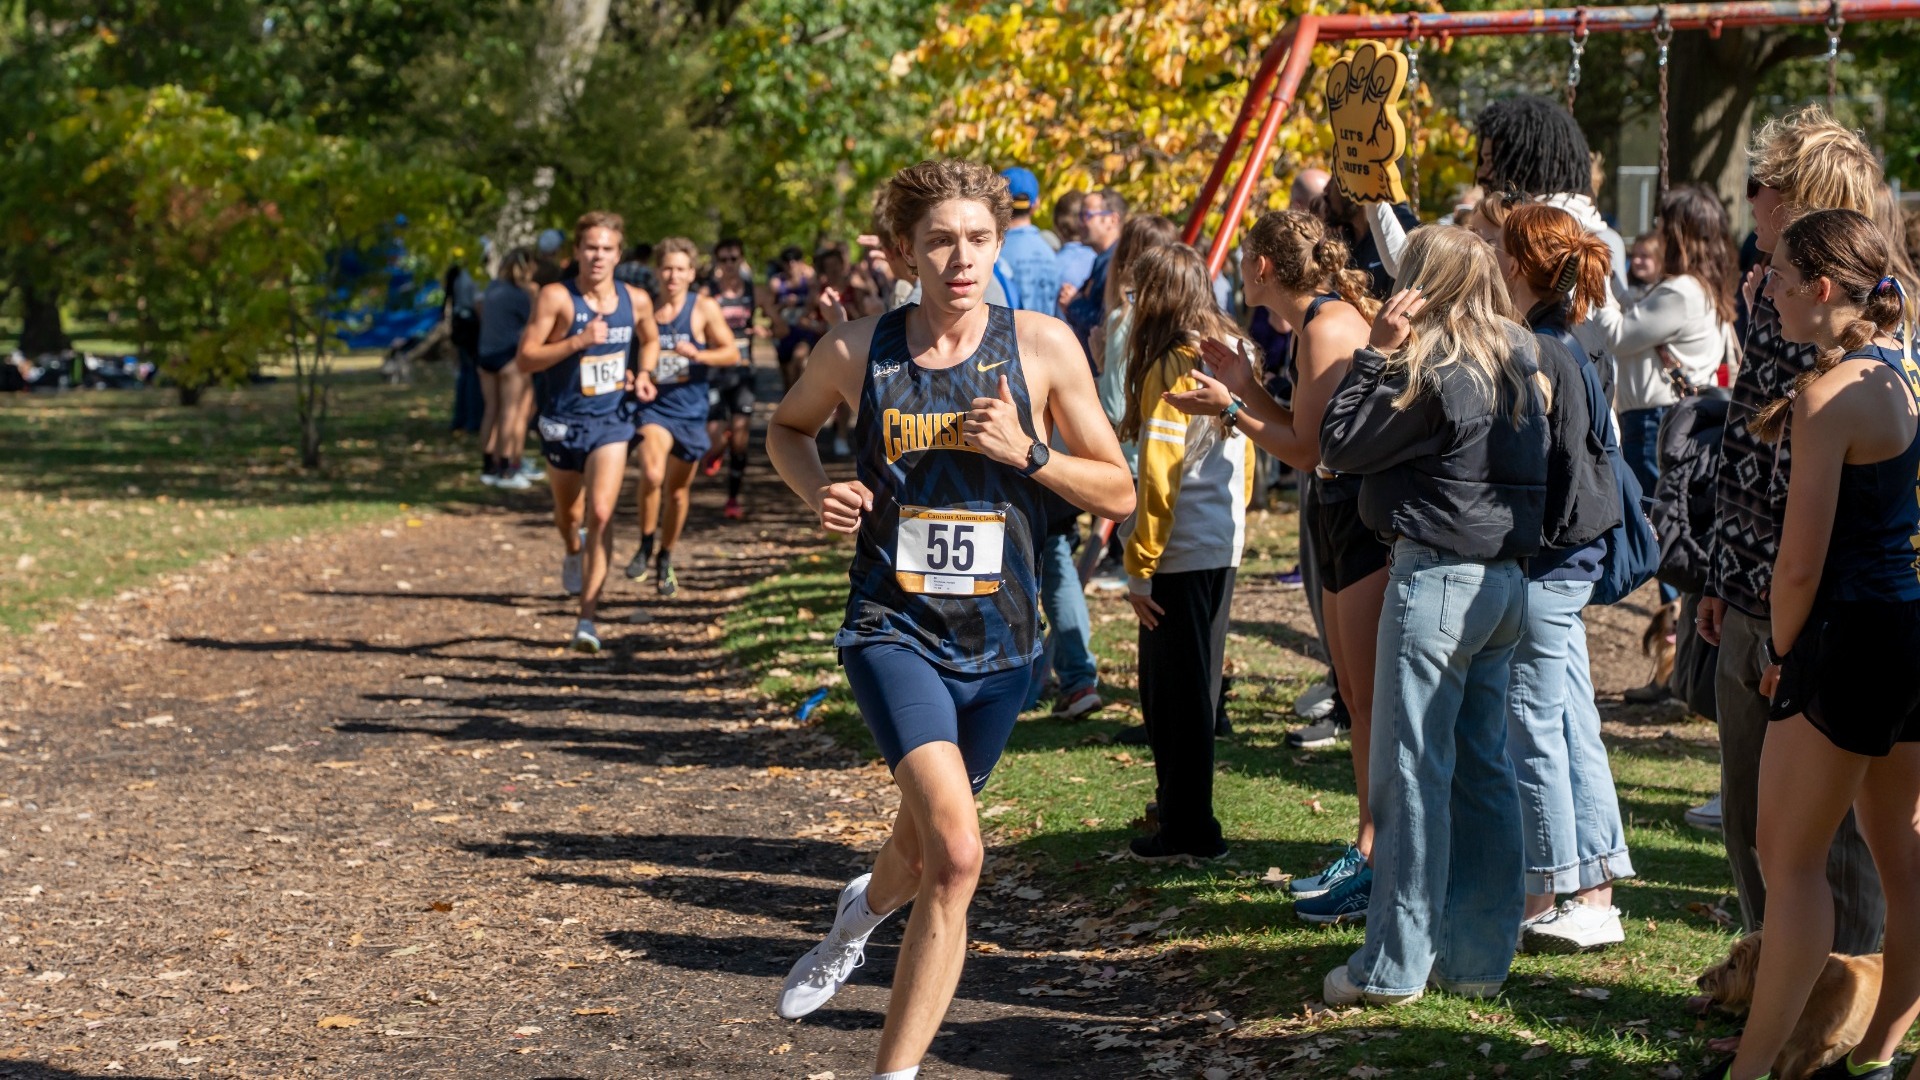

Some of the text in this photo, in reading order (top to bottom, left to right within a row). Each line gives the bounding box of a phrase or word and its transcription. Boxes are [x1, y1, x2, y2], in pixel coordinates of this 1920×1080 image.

[1340, 128, 1363, 142] LET'S
[1346, 146, 1358, 158] GO
[1340, 161, 1370, 176] RIFFS
[590, 359, 619, 384] 162
[883, 408, 974, 465] CANISI
[927, 512, 954, 521] Canisius
[955, 513, 978, 522] Alumni
[926, 523, 975, 572] 55
